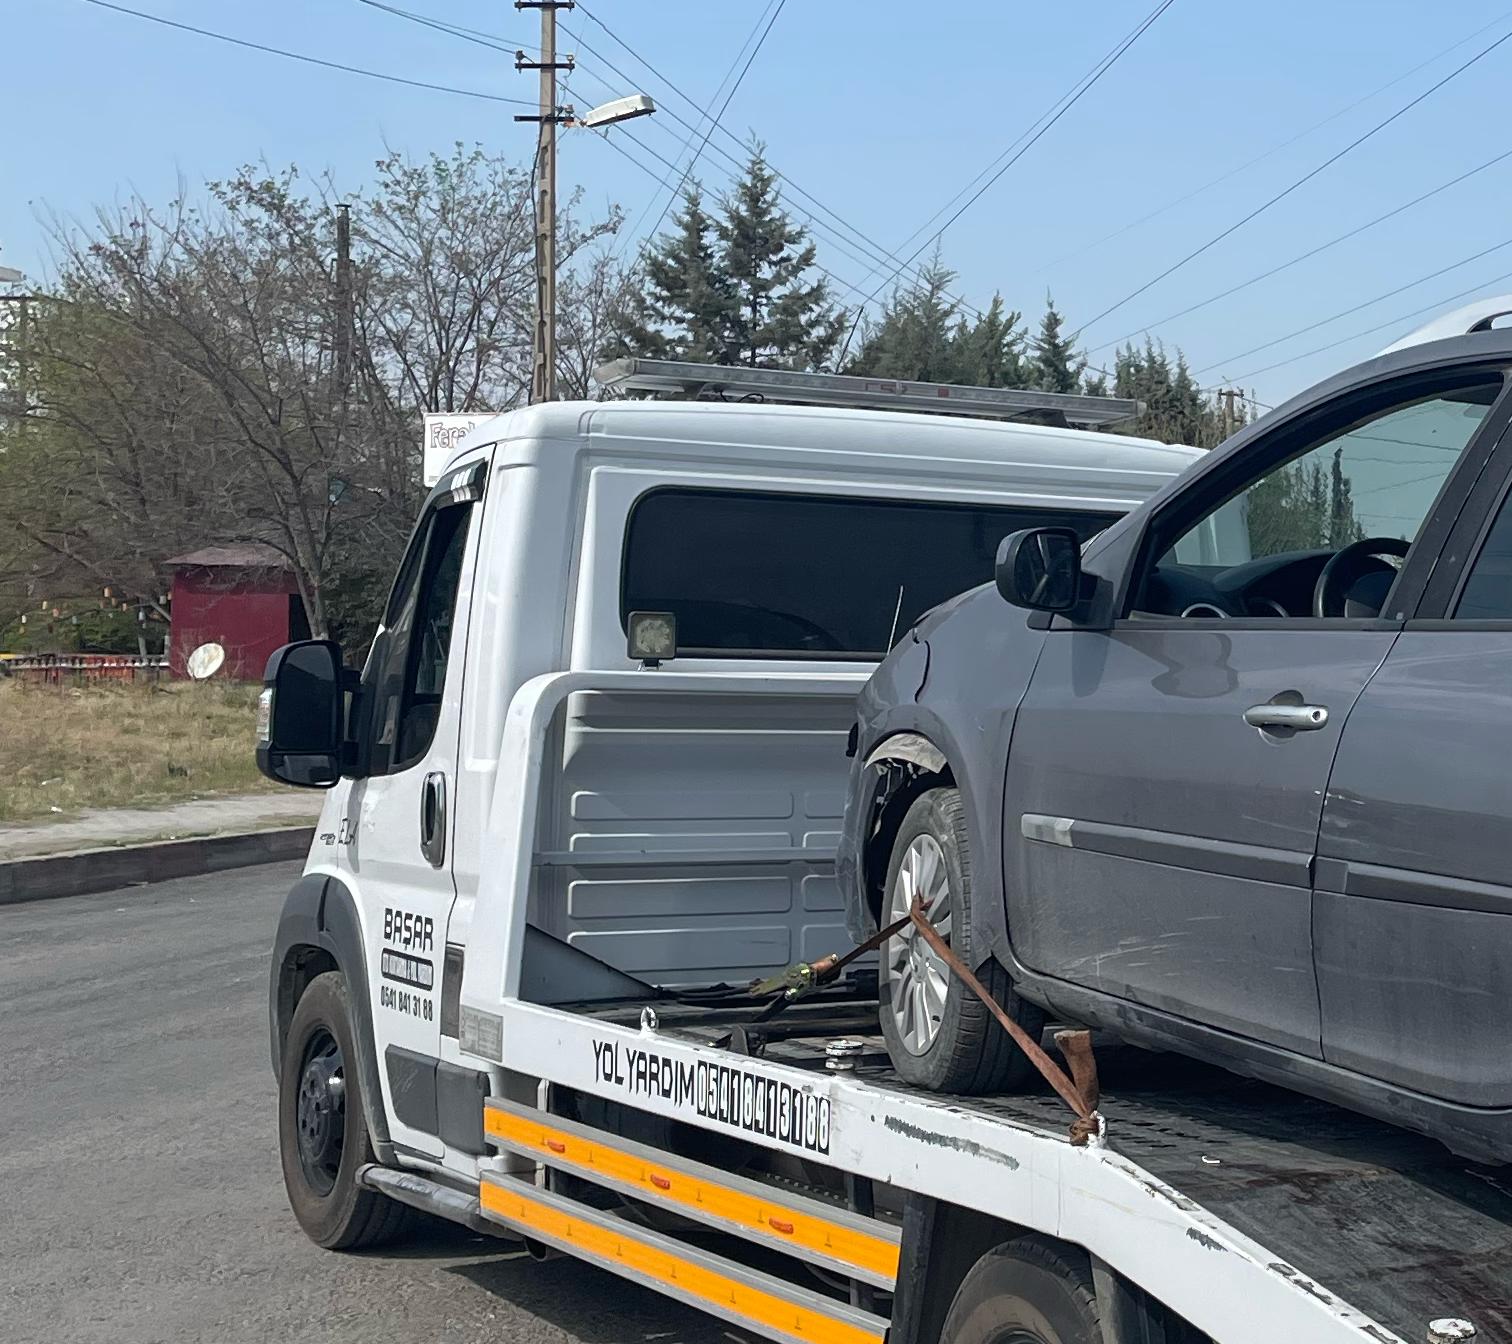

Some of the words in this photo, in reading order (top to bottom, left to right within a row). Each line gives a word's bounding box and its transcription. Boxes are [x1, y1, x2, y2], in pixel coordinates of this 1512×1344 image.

[384, 907, 433, 953] BAŞAR
[592, 1039, 625, 1086] YOL
[626, 1047, 695, 1108] YARDIM
